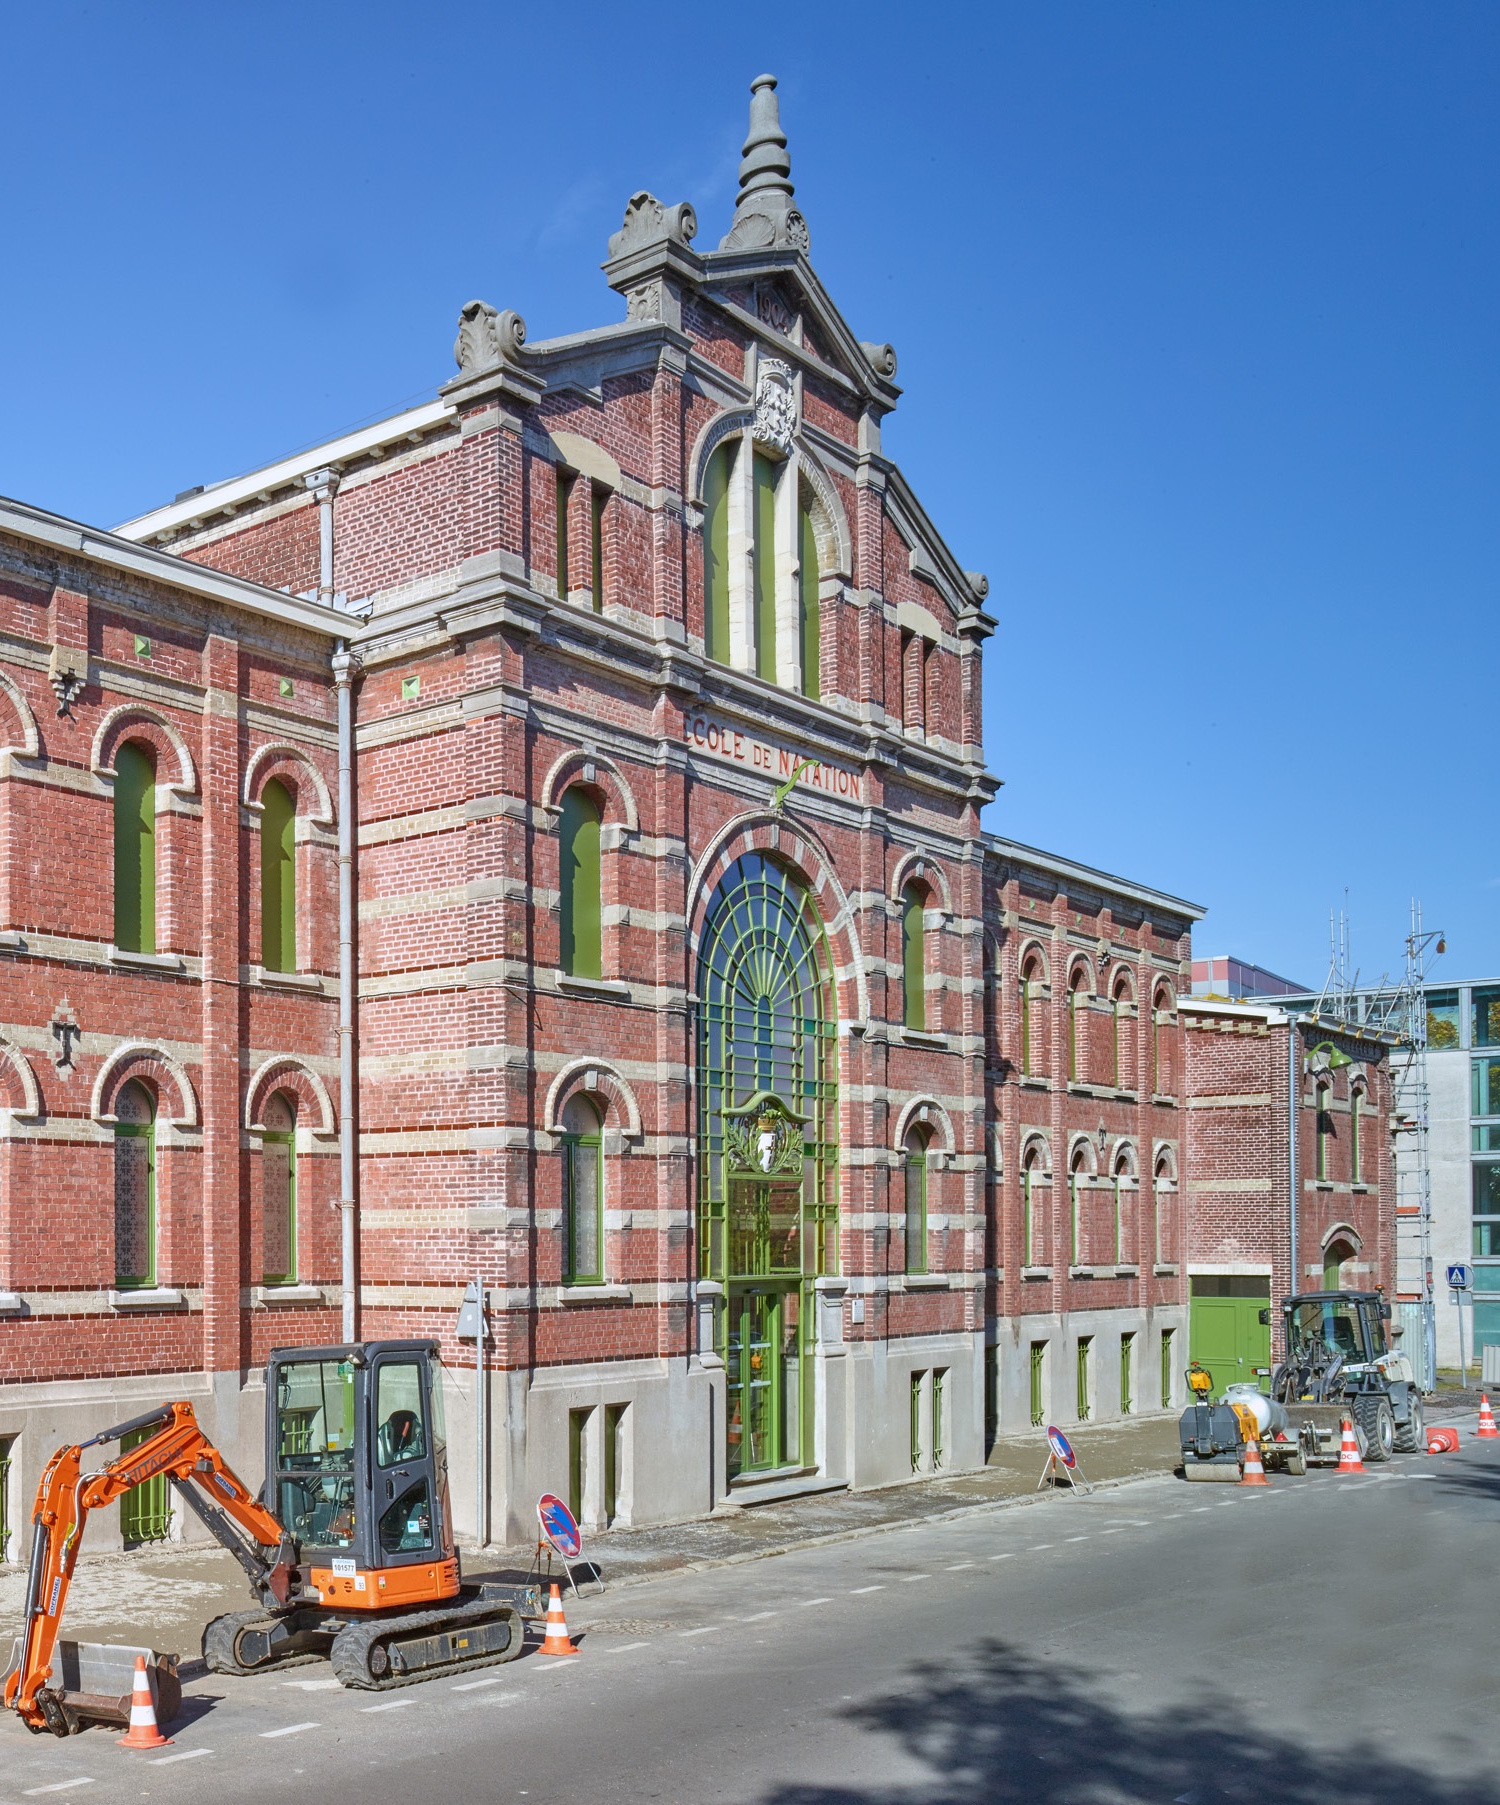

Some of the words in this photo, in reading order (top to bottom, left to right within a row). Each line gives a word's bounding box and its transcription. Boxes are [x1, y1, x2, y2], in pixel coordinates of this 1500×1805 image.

[754, 744, 772, 769] DE
[778, 746, 860, 800] NATATION
[129, 1446, 184, 1485] HITACHI
